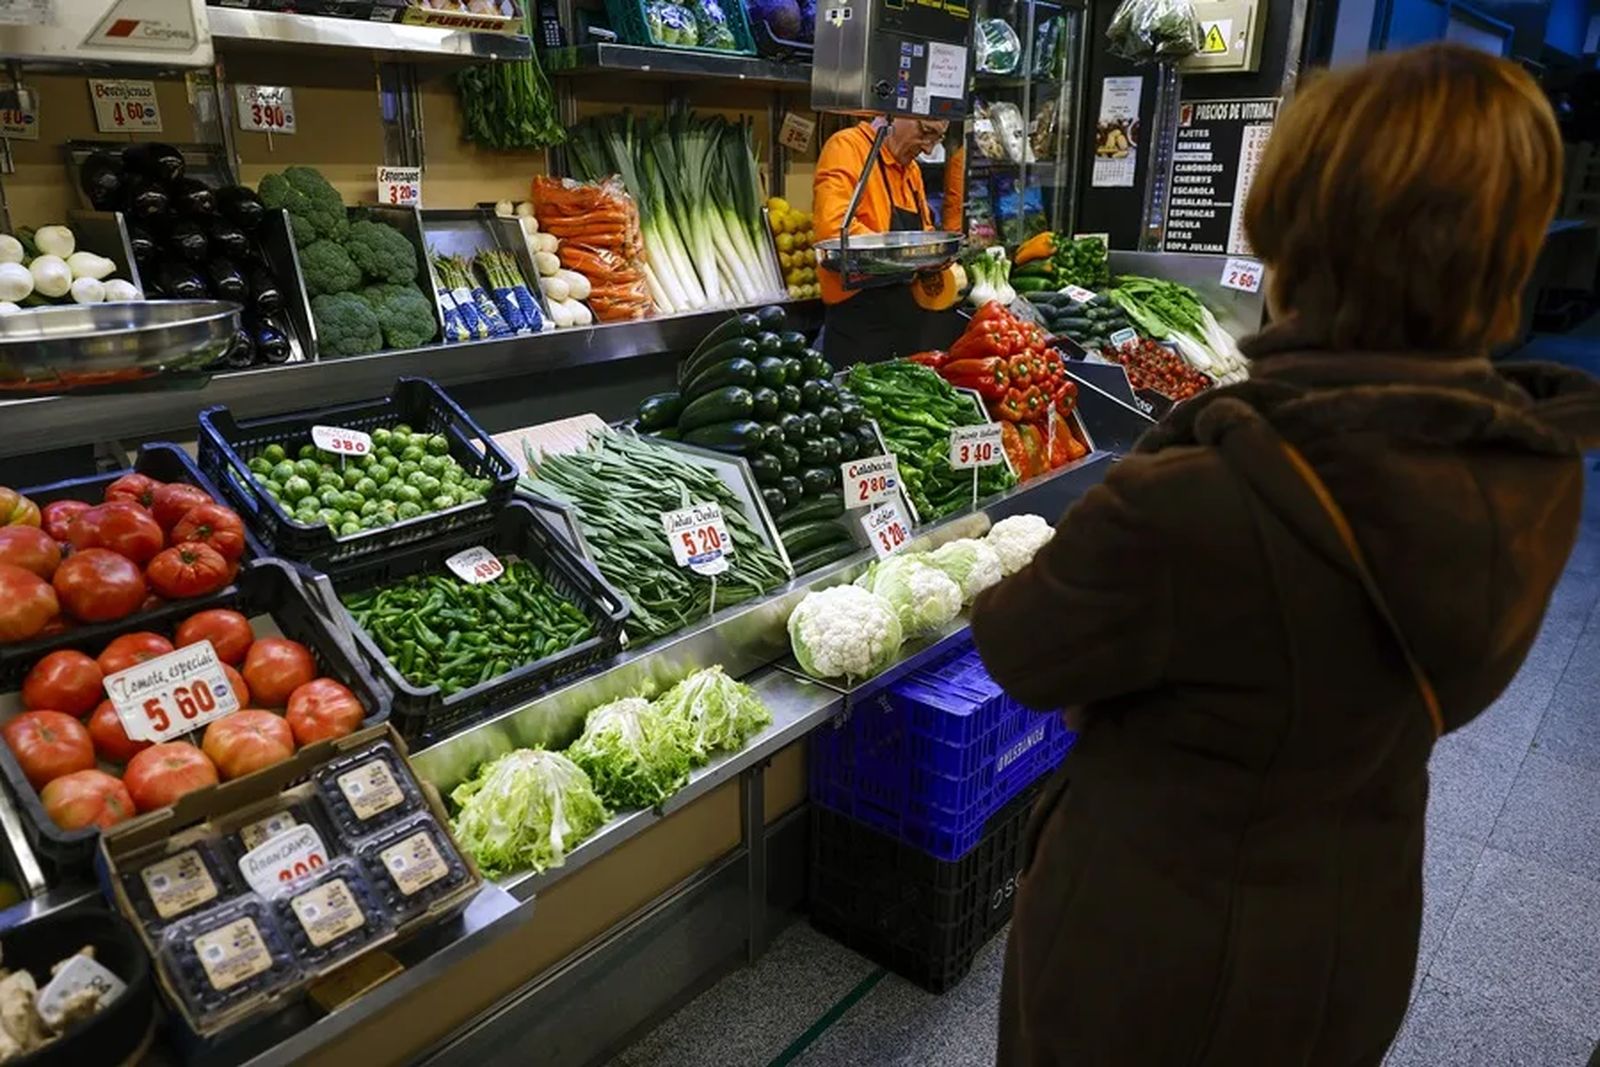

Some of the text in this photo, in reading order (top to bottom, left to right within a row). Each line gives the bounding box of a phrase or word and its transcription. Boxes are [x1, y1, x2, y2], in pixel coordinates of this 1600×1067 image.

[426, 15, 505, 30] FUENTES
[1195, 102, 1274, 120] PRECIOS DE VITRINA
[1178, 129, 1210, 138] AJETES
[1174, 163, 1224, 173] CANÓNIGOS
[1173, 175, 1213, 184] CHERRYS
[1172, 186, 1216, 196] ESCAROLA
[1171, 198, 1213, 206] ENSALADA
[1170, 209, 1216, 218] ESPINACAS
[1168, 219, 1201, 229] RÚCULA
[1167, 231, 1193, 240] SETAS
[1166, 241, 1188, 251] SOPA
[1188, 242, 1224, 253] JULIANA
[858, 475, 887, 501] 2'80
[681, 525, 721, 556] 5'20
[168, 647, 213, 680] especial
[142, 680, 216, 732] 5'60
[997, 725, 1045, 772] FONTESTAD
